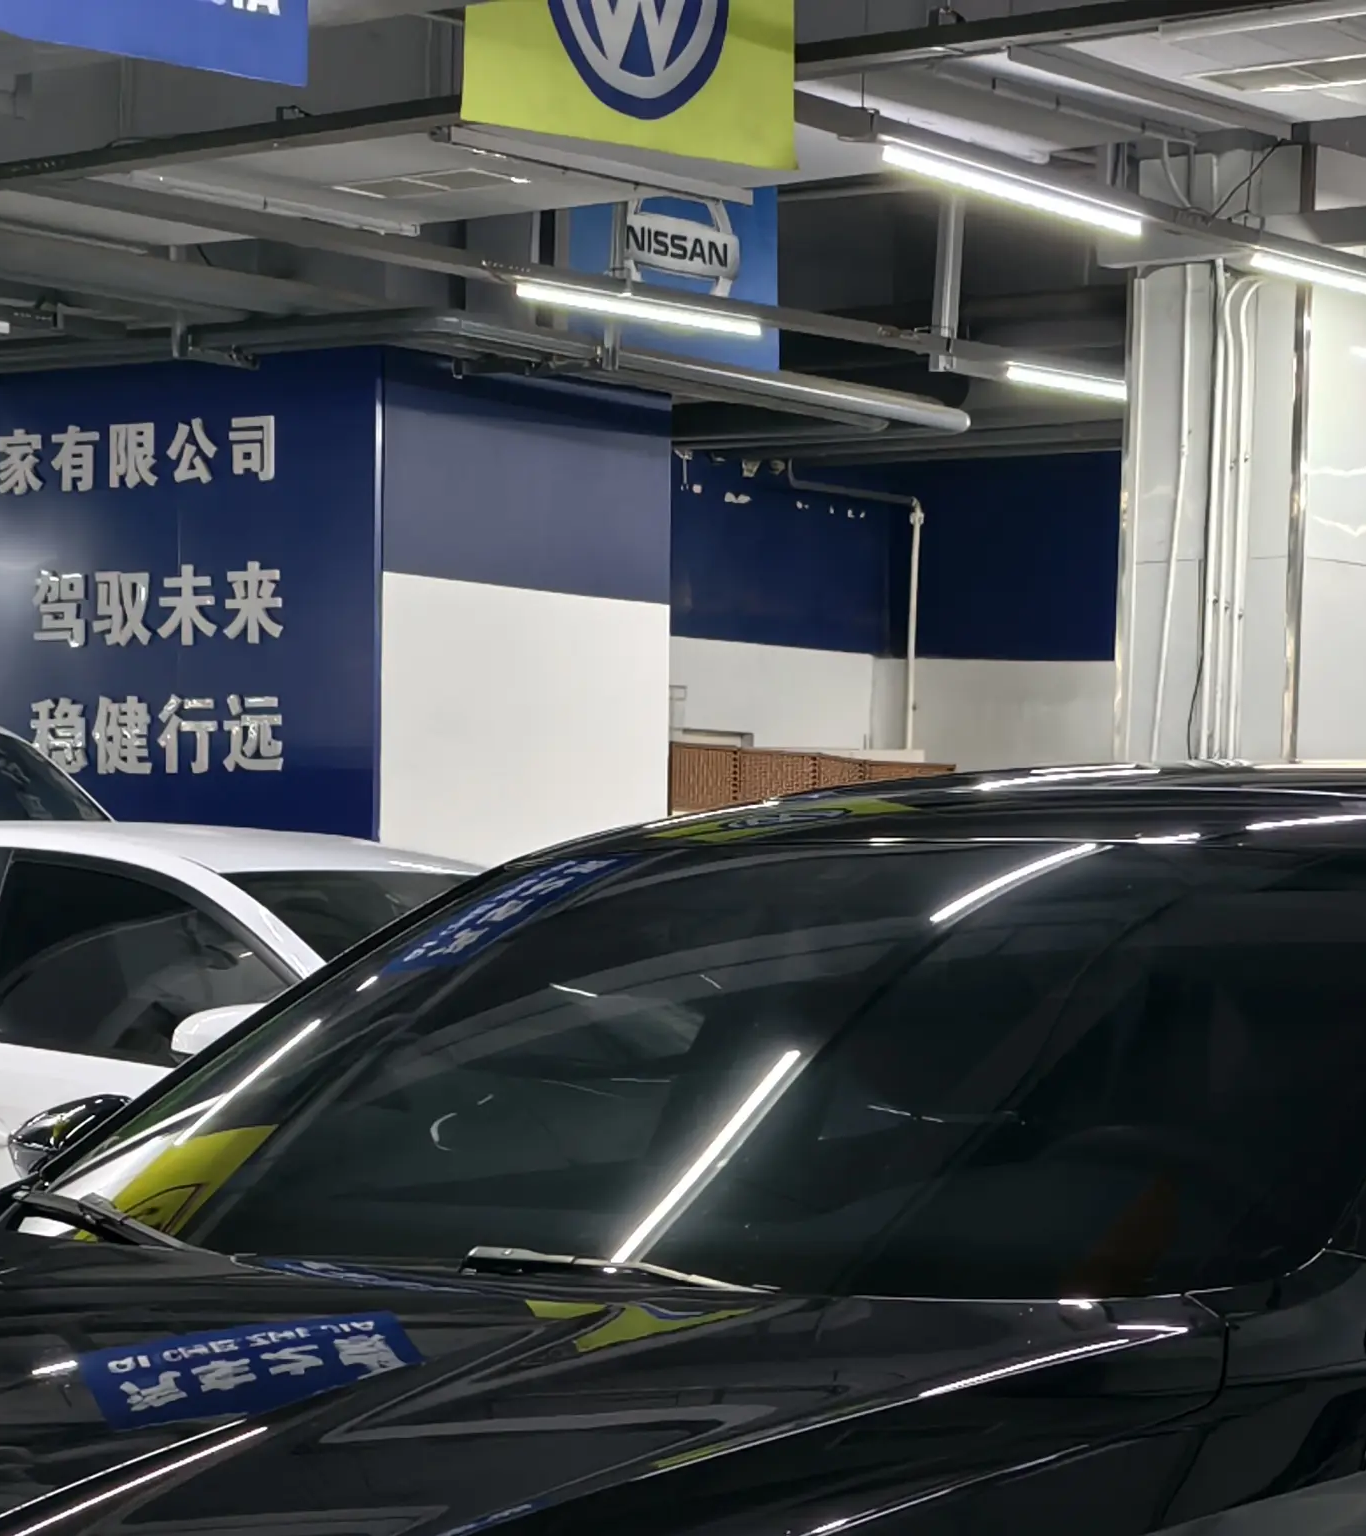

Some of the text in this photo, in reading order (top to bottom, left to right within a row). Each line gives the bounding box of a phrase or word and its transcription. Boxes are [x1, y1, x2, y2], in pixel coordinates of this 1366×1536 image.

[626, 224, 729, 269] NISSAN
[32, 560, 286, 650] 驾驭未来
[30, 693, 285, 776] 稳健行远
